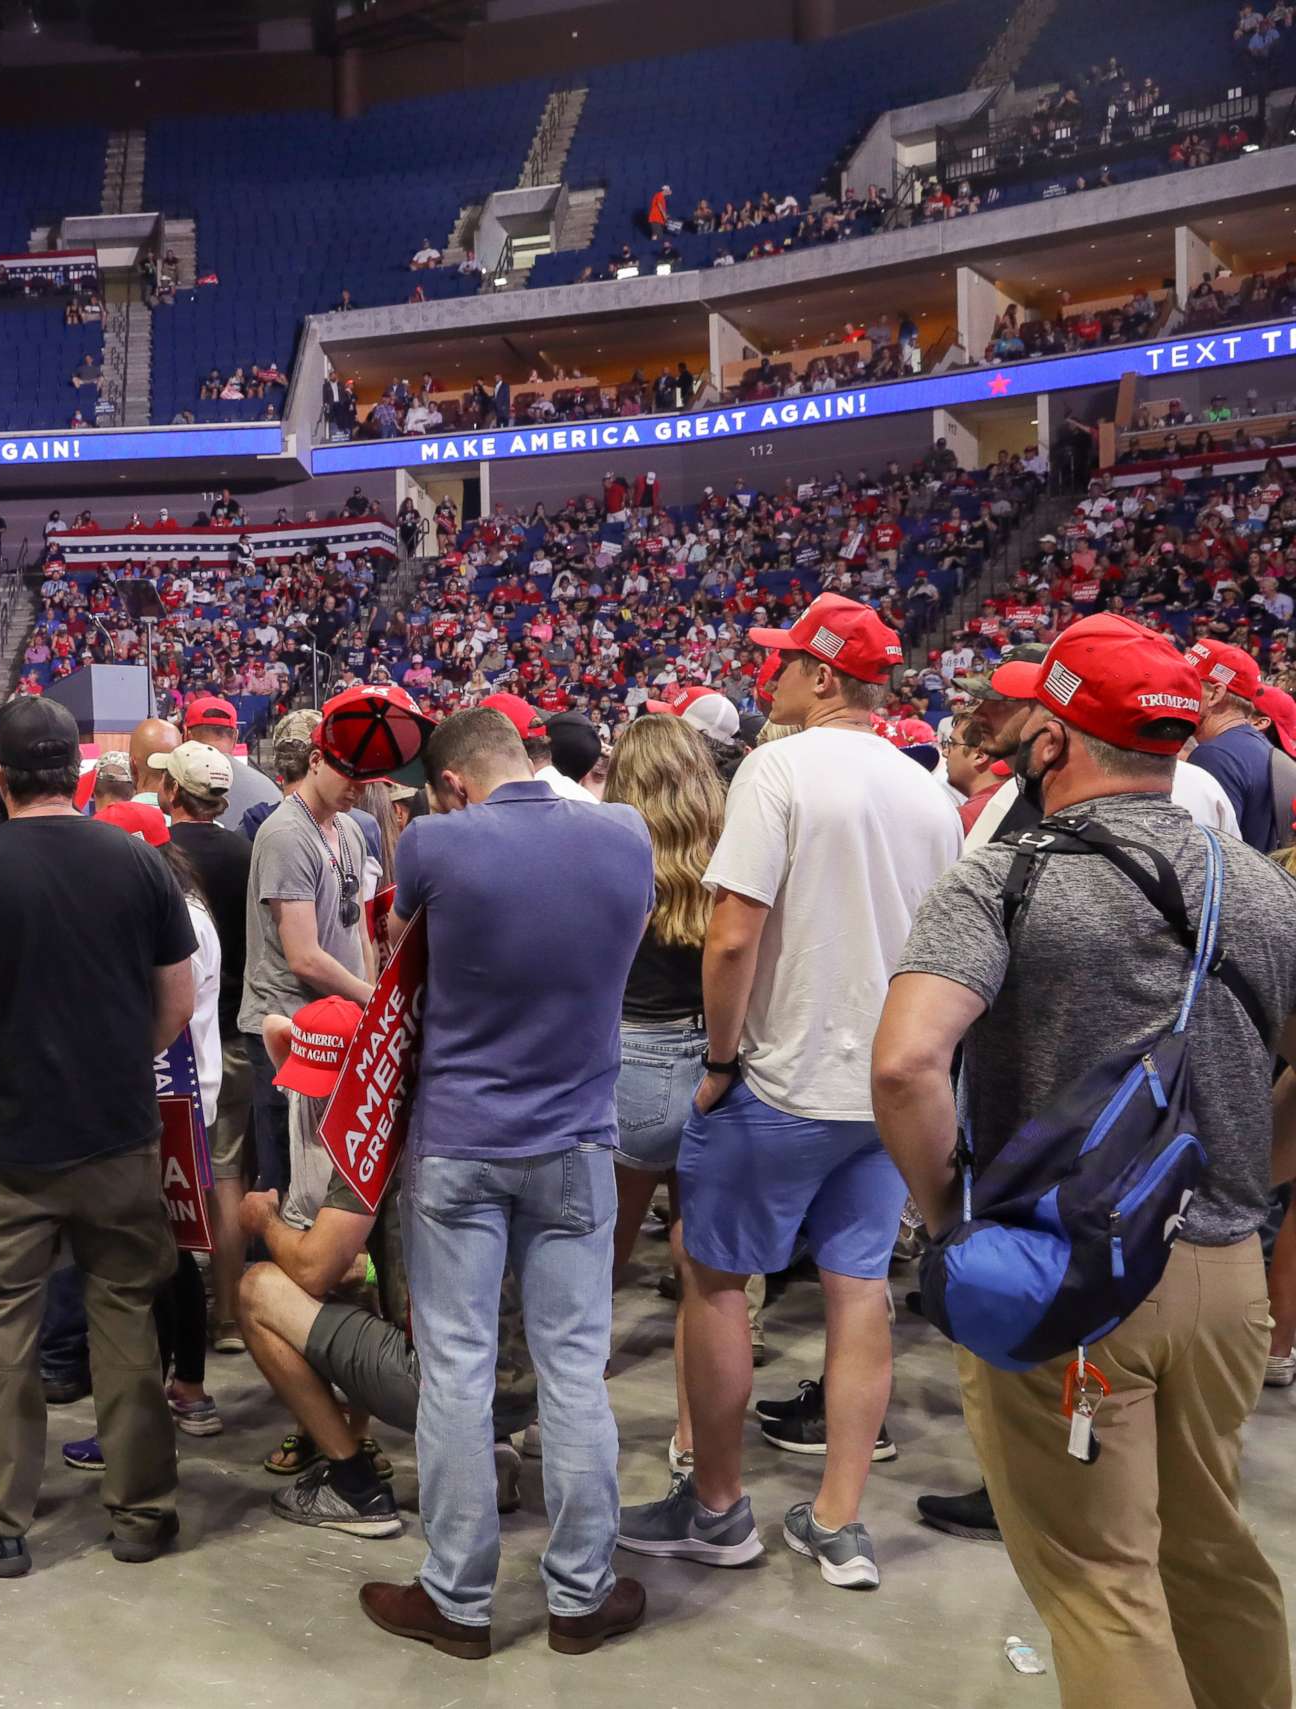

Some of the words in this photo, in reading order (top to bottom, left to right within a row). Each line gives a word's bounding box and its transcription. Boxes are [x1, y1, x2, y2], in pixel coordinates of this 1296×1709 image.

[1146, 336, 1242, 371] TEXT
[421, 436, 496, 461] MAKE
[509, 424, 641, 454] AMERICA
[655, 410, 746, 441] GREAT
[760, 393, 867, 427] AGAIN!
[749, 443, 773, 457] 112
[301, 1031, 345, 1049] AMERICA
[307, 1048, 338, 1063] AGAIN
[355, 984, 406, 1082] MAKE
[345, 983, 426, 1169] AMERIC
[358, 1074, 408, 1183] GREAT
